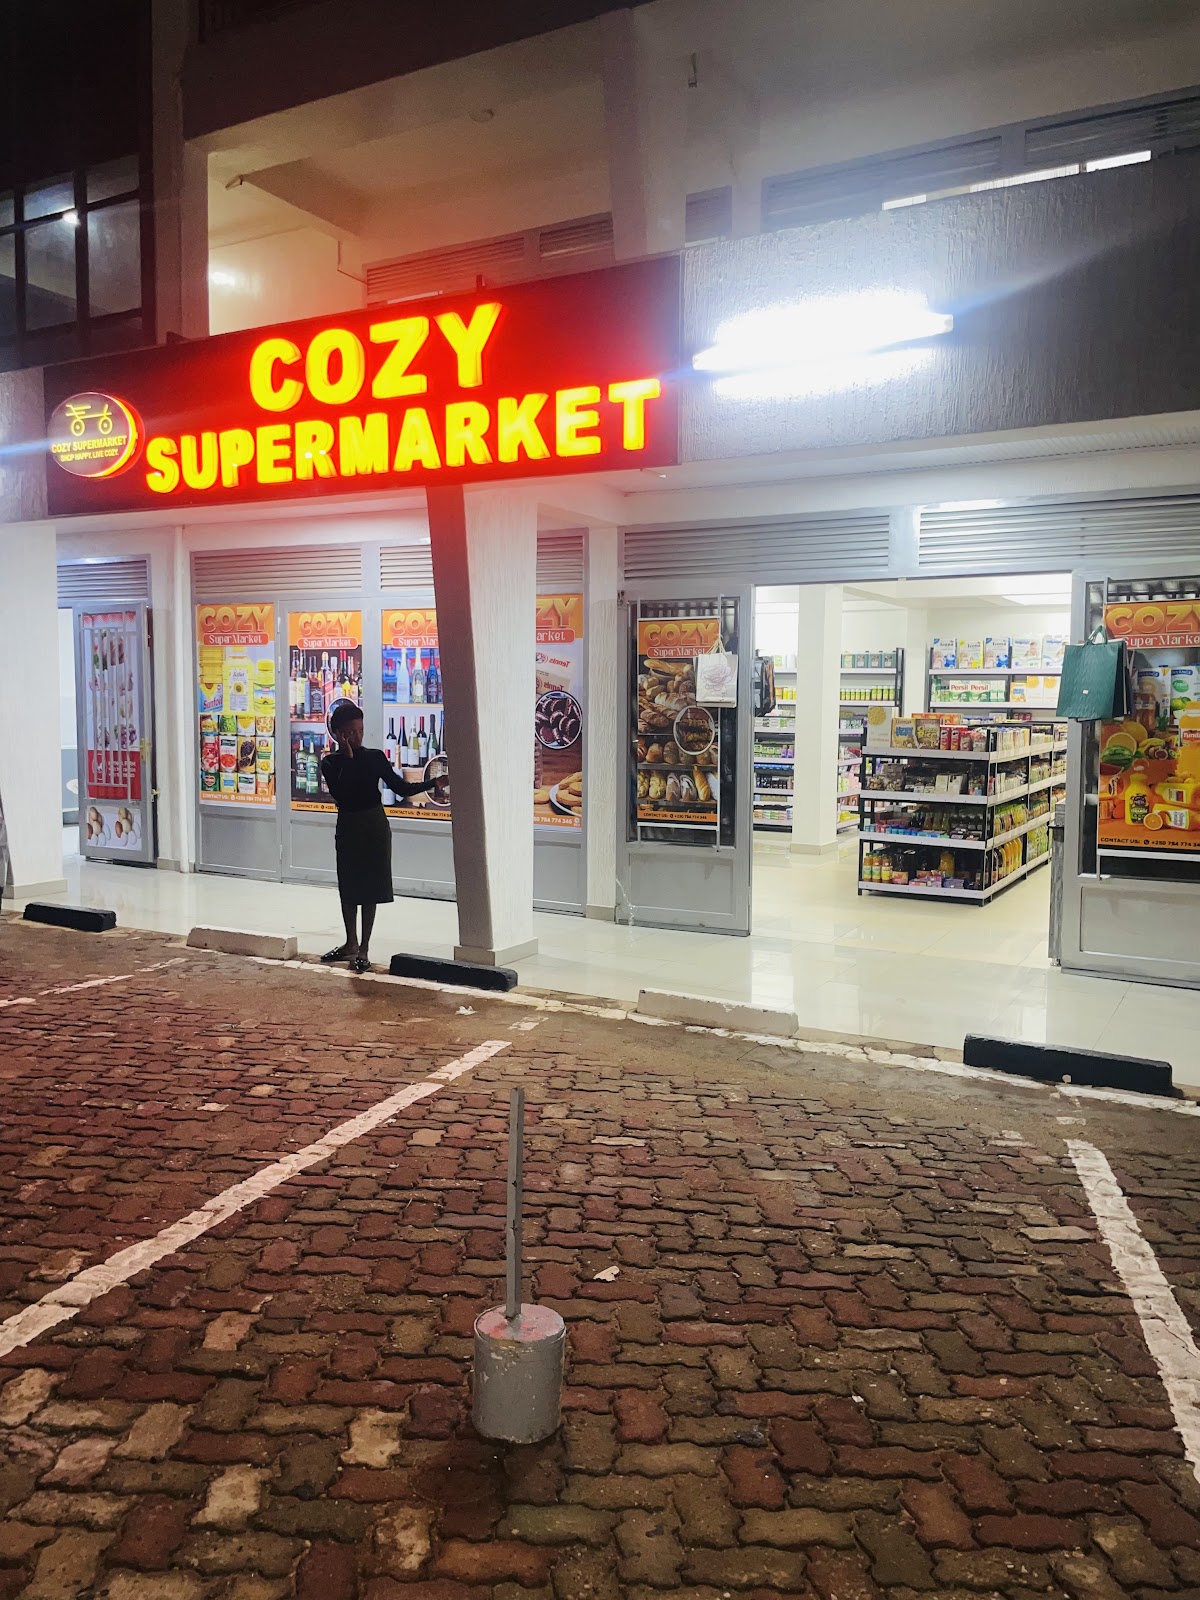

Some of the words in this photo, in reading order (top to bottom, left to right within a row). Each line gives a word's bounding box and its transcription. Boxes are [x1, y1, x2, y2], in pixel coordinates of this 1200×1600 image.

[249, 302, 503, 412] COZY
[51, 442, 72, 453] COZY
[73, 435, 127, 451] SUPERMARKET
[145, 378, 661, 493] SUPERMARKET
[60, 453, 75, 462] SHOP
[200, 606, 271, 633] COZY
[299, 612, 353, 636] COZY
[388, 611, 438, 636] COZ
[644, 622, 716, 647] COZY
